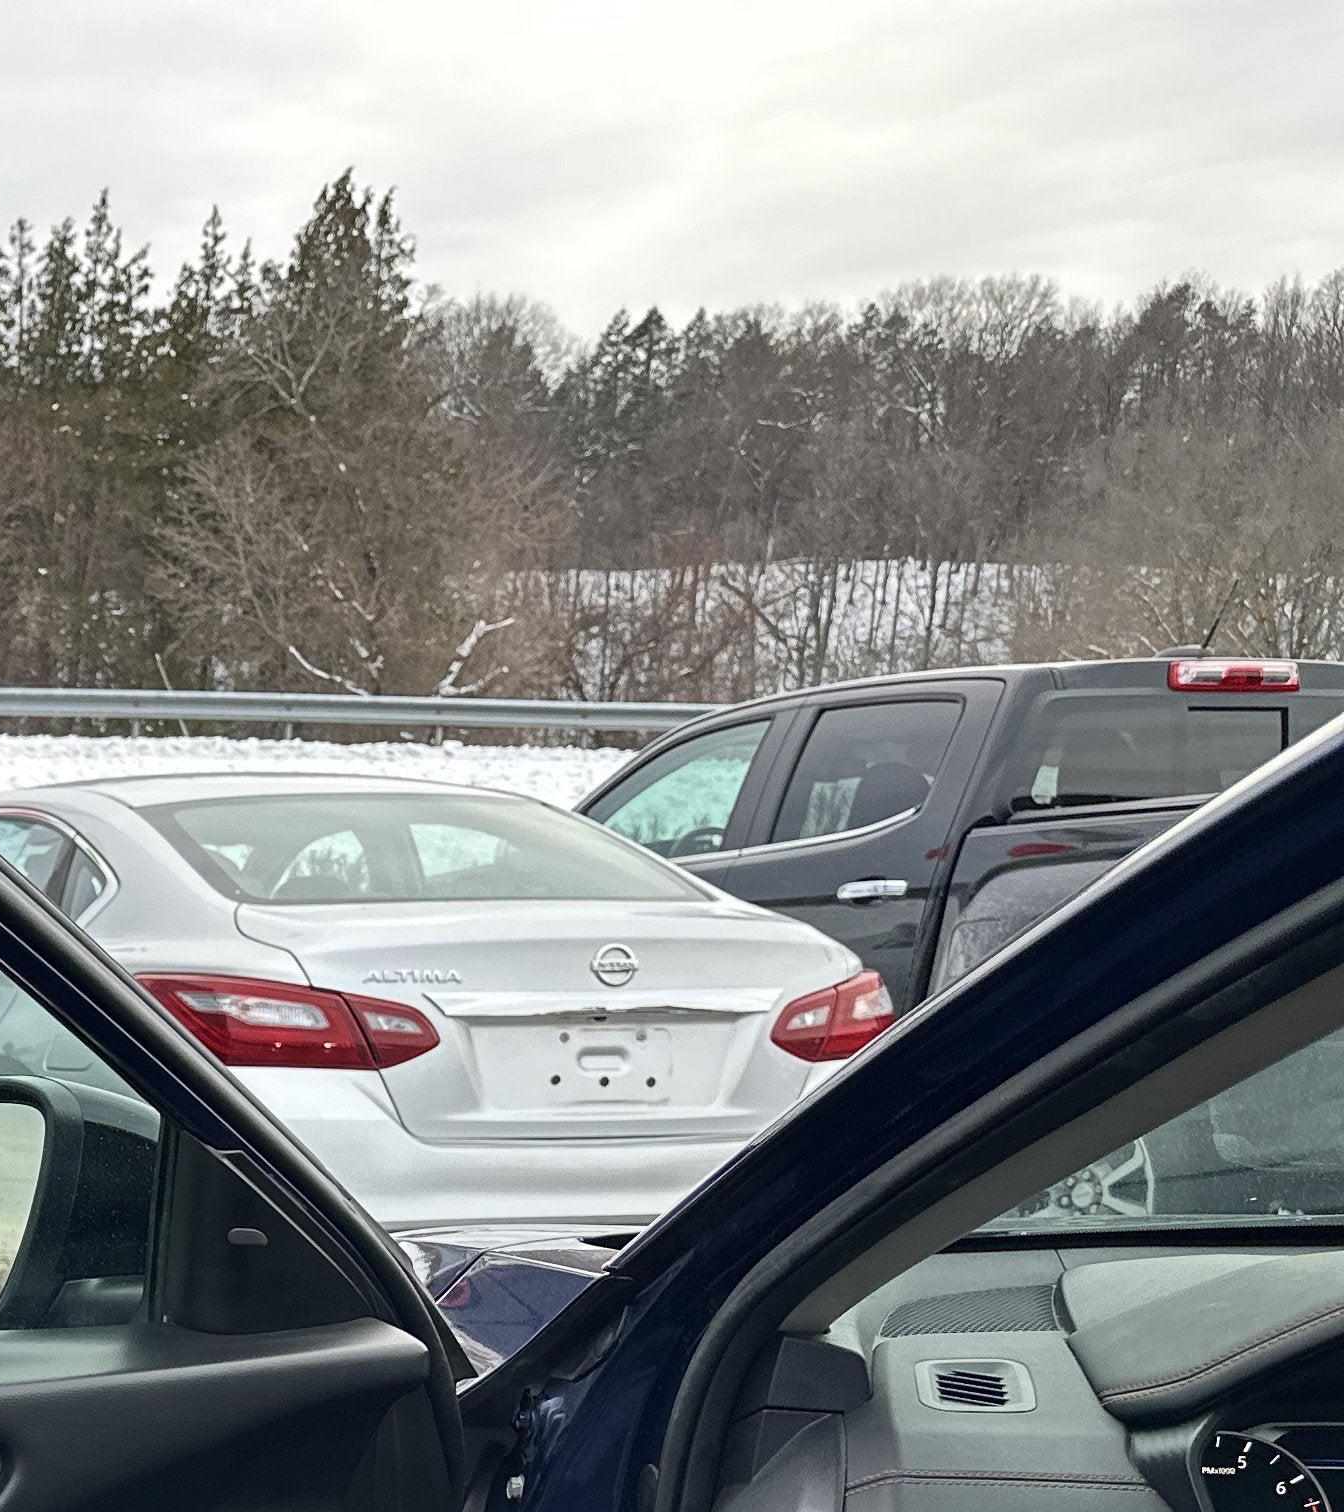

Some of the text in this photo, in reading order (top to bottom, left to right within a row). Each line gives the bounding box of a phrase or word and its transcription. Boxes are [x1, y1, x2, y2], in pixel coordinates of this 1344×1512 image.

[362, 968, 462, 985] ALTIMA
[1237, 1455, 1247, 1469] 5
[1201, 1467, 1236, 1475] PMx1000
[1275, 1481, 1287, 1495] 6
